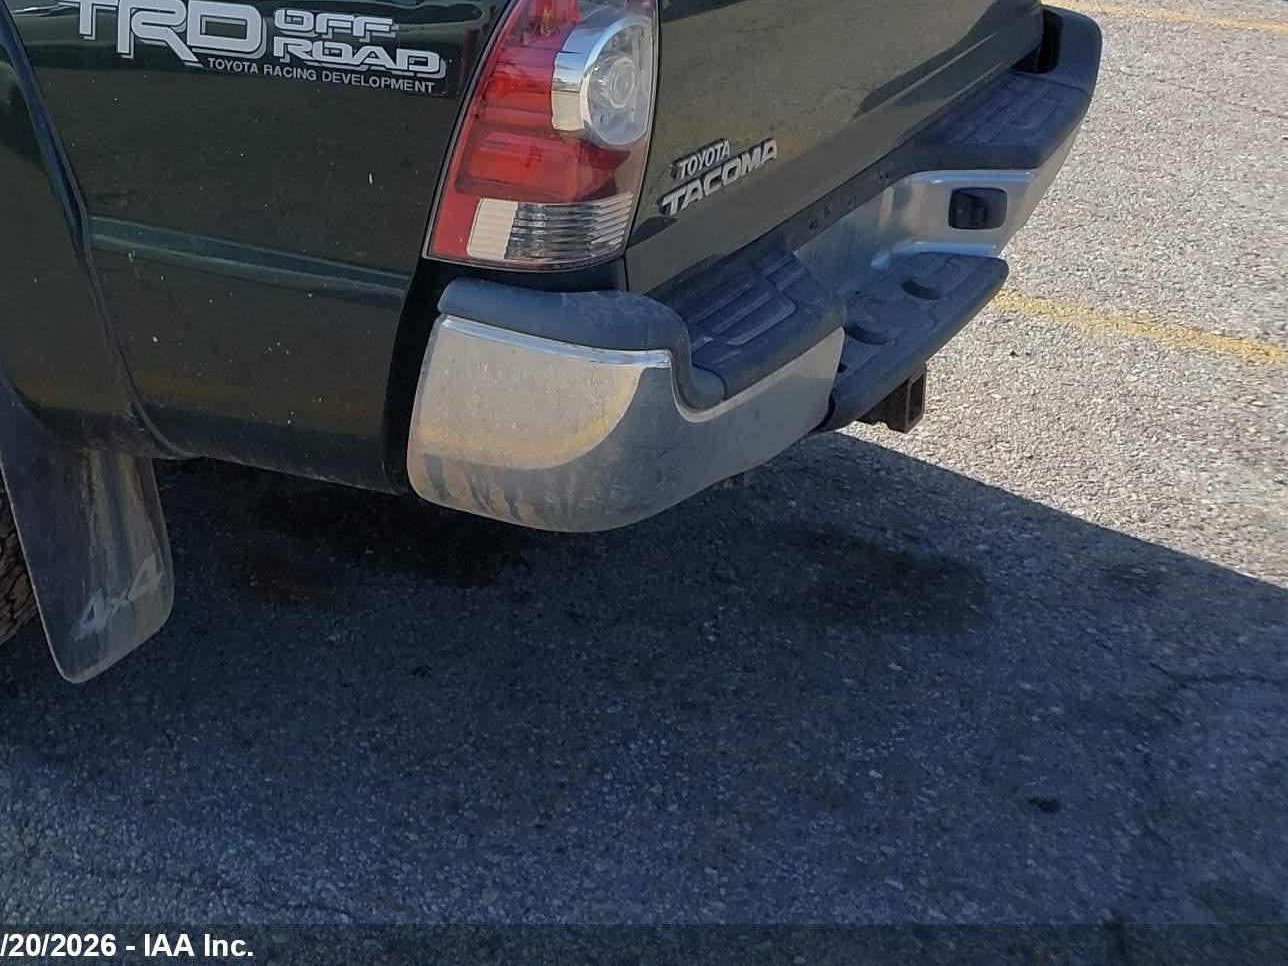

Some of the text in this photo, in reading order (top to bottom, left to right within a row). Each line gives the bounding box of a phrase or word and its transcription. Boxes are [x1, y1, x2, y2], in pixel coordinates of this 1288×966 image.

[273, 8, 399, 42] OFF
[208, 56, 435, 94] TOYOTA RACING DEVELOPMENT
[273, 35, 447, 79] ROAD
[662, 138, 778, 217] TACOMA
[678, 139, 731, 180] TOYOTA
